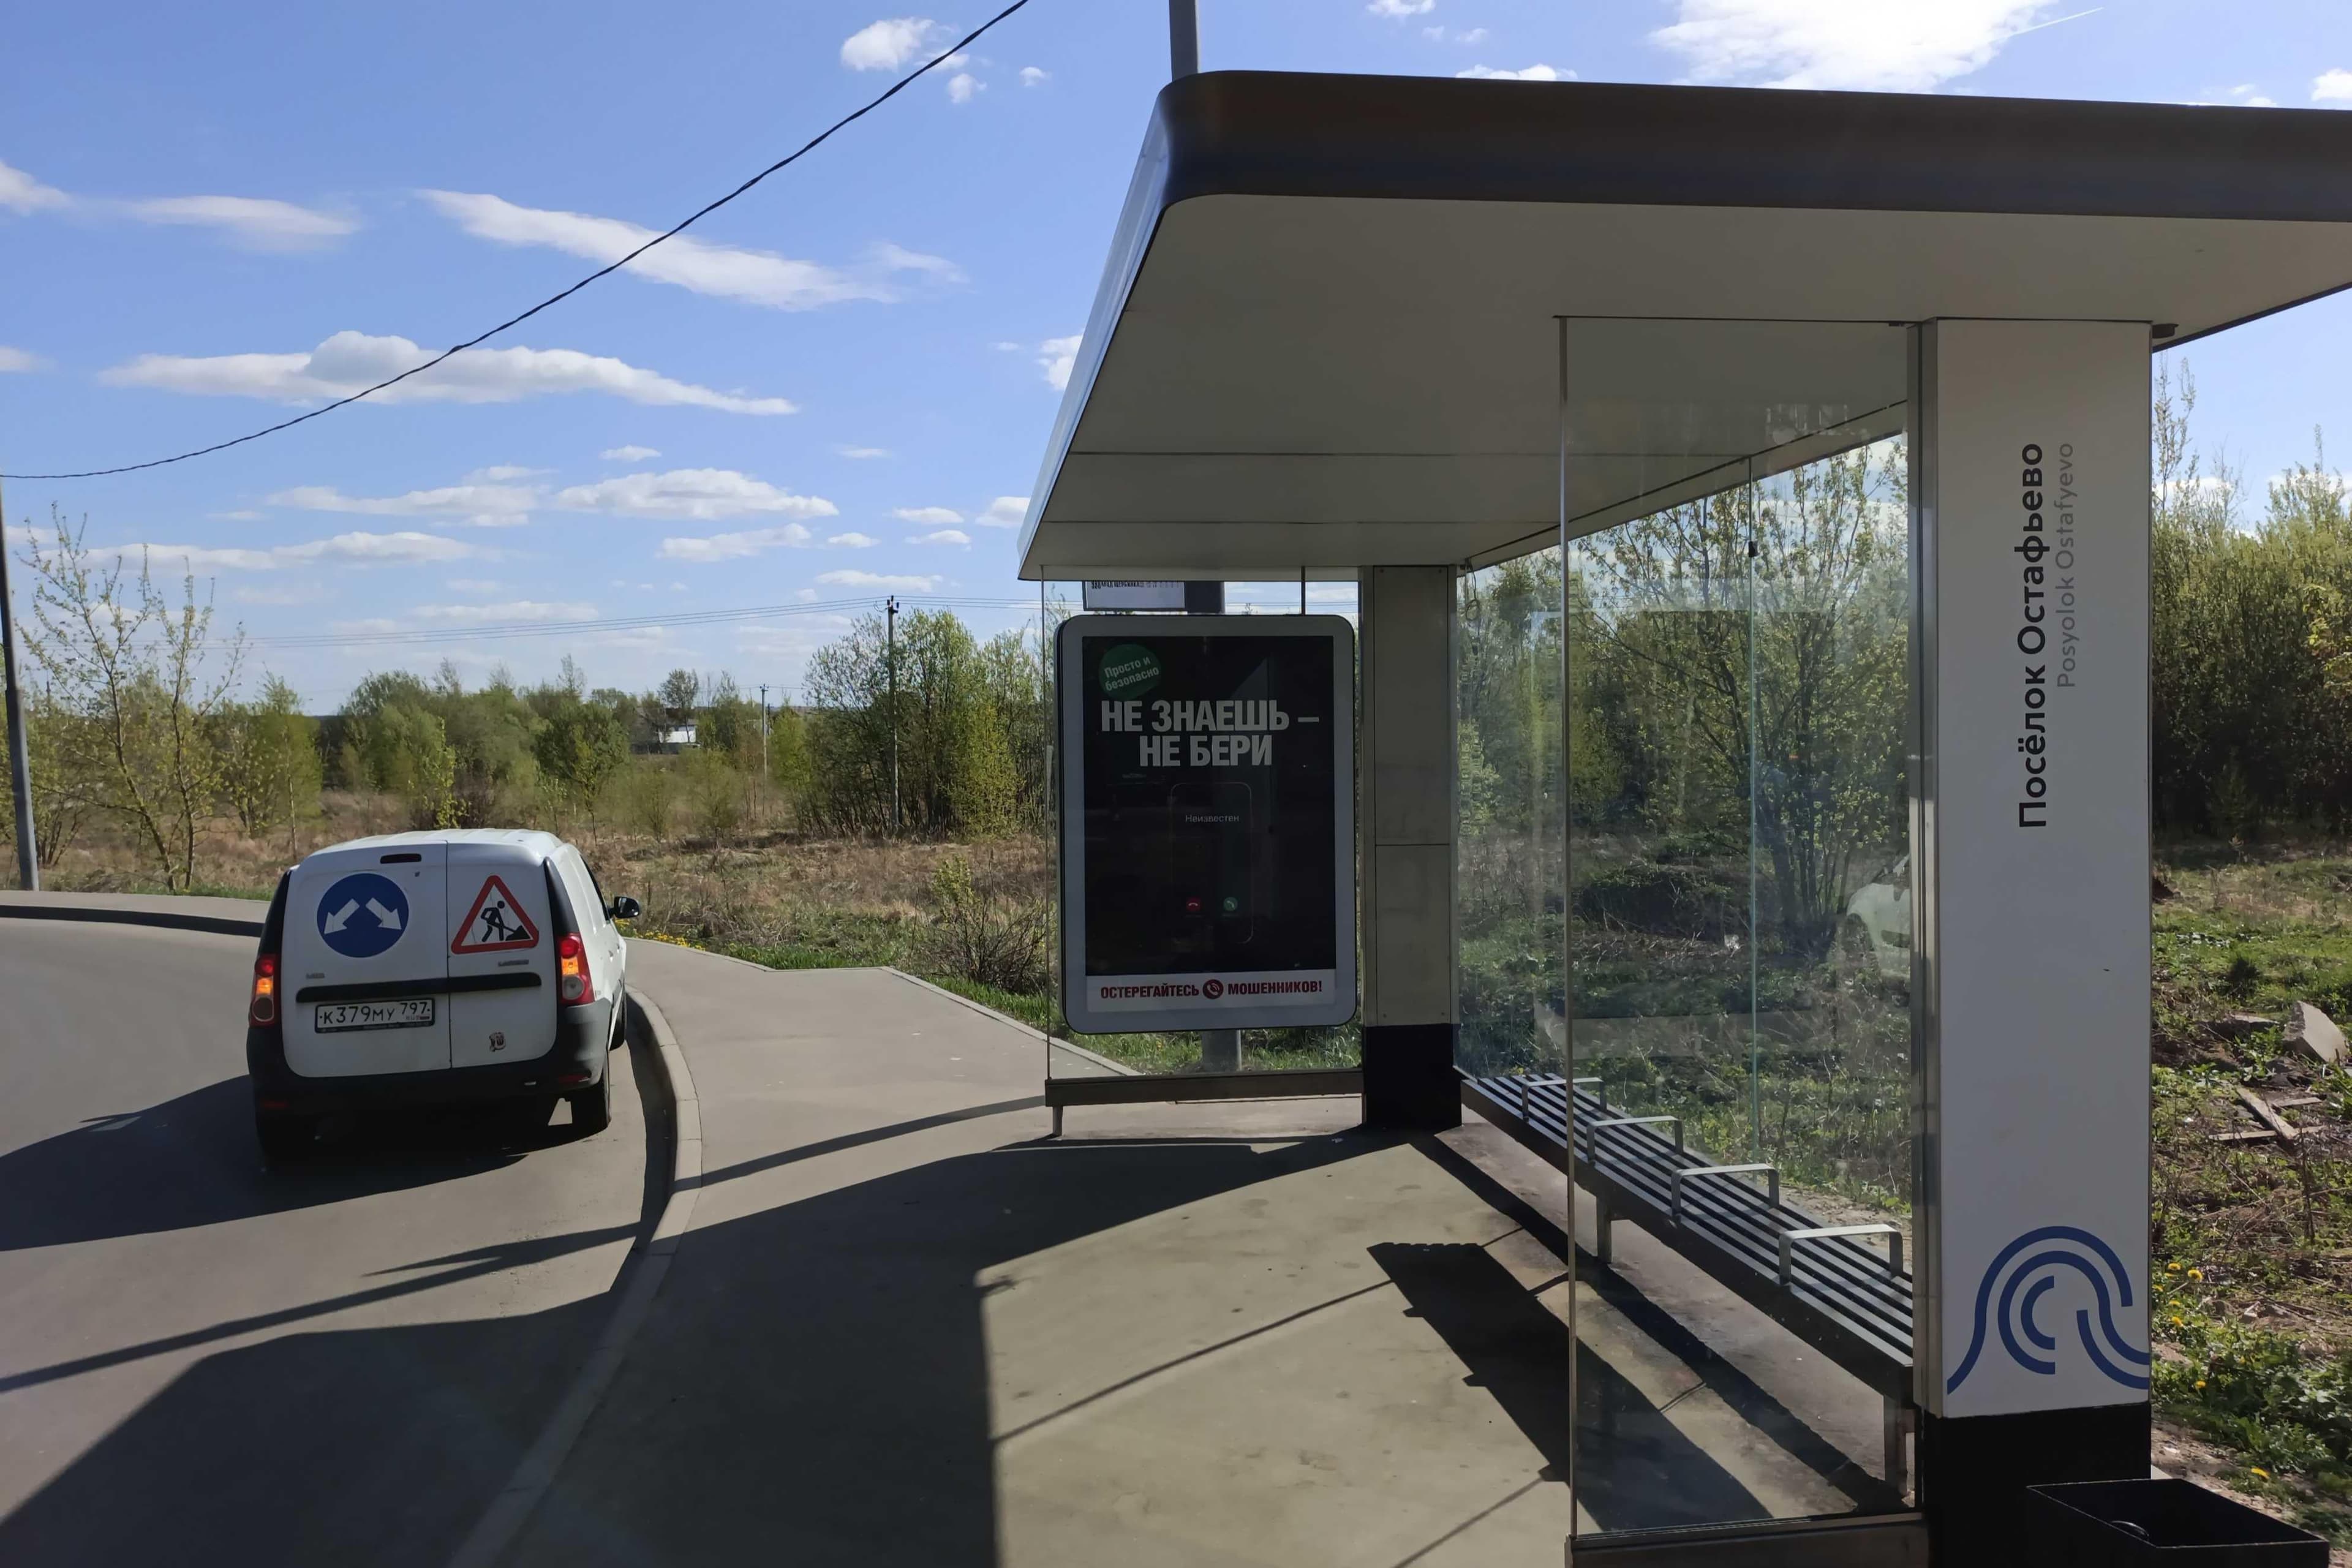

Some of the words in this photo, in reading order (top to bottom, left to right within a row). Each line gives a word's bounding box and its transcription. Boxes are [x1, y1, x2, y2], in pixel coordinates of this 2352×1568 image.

[2054, 443, 2078, 570] Ostafyevo
[2014, 443, 2051, 655] Остафьево
[2054, 576, 2080, 687] Posyolok
[1104, 660, 1141, 678] Просто
[1142, 656, 1152, 666] и
[1105, 667, 1160, 692] безопасно
[1101, 700, 1143, 732] НЕ
[1151, 699, 1290, 733] ЗНАЕШЬ
[1139, 735, 1181, 767] НЕ
[1189, 734, 1273, 766] БЕРИ
[2018, 664, 2047, 827] Посёлок
[1101, 982, 1200, 999] ОСТЕРЕГАЙТЕСЬ
[1227, 981, 1323, 995] МОШЕННИКОВ!
[400, 1002, 428, 1015] 797
